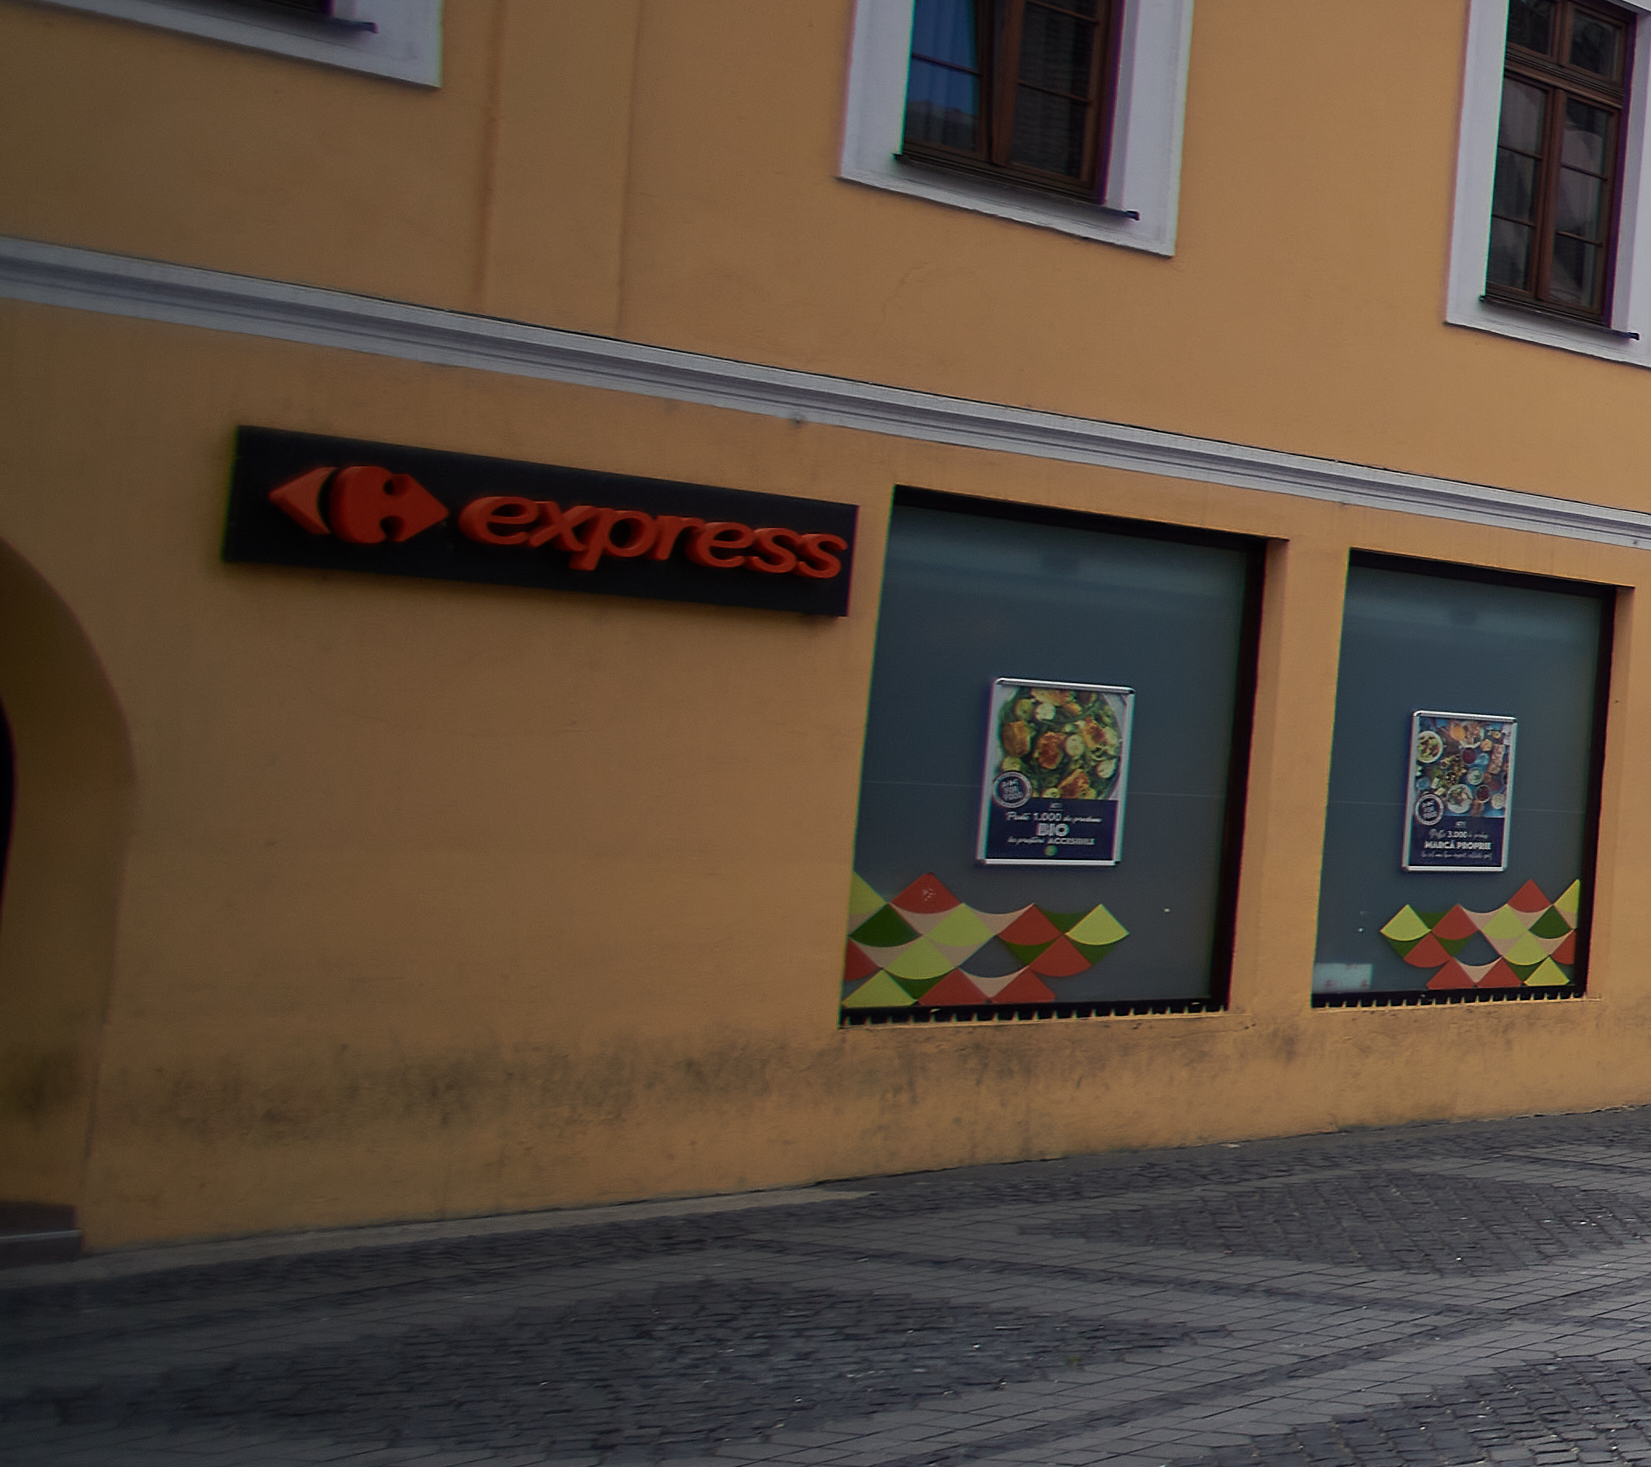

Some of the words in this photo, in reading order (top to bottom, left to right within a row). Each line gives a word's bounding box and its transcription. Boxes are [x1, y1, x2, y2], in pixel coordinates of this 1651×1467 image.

[459, 494, 849, 580] express
[1033, 813, 1062, 822] 1.000
[1037, 823, 1070, 837] BIO
